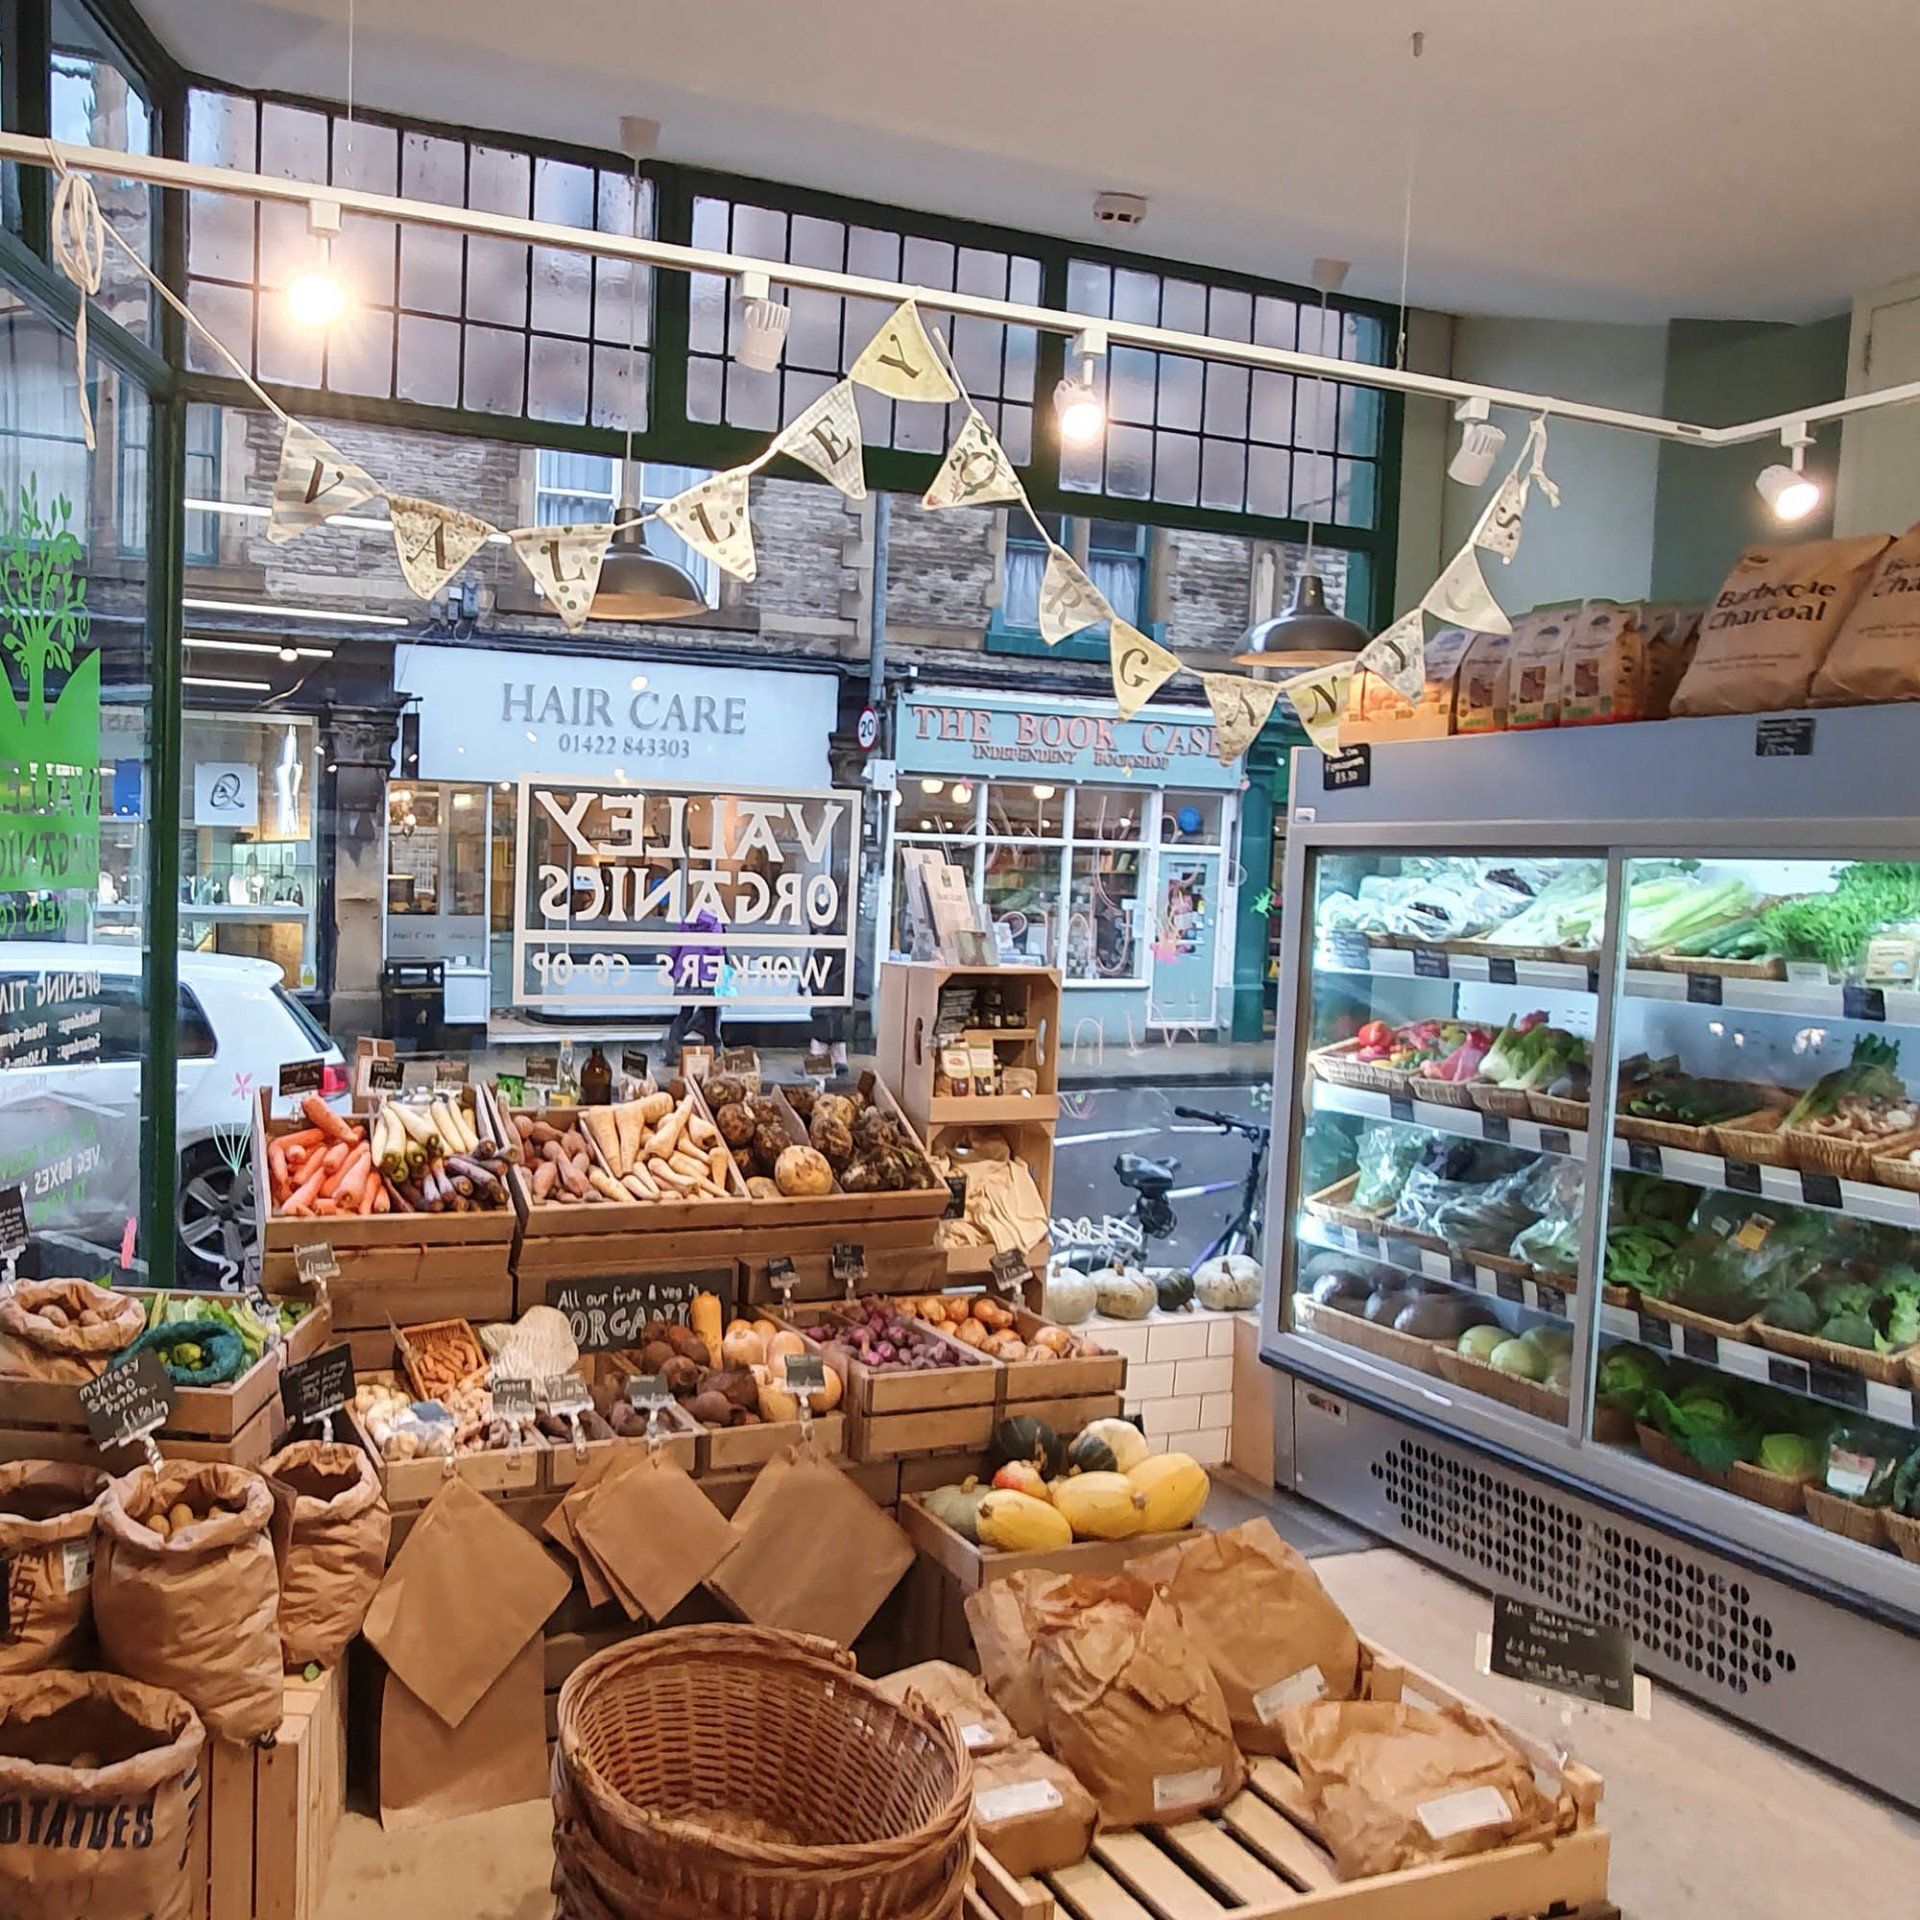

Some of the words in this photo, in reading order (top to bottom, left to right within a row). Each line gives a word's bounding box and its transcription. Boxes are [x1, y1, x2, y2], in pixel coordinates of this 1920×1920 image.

[1708, 601, 1826, 630] Charcoal
[501, 682, 614, 726] HAIR
[629, 690, 748, 735] CARE
[860, 718, 874, 738] 20
[911, 705, 993, 743] THE
[1015, 713, 1119, 752] BOOK
[558, 732, 616, 756] 01422
[622, 735, 691, 759] 843303
[972, 744, 1077, 765] INDEPENDENT
[1093, 752, 1169, 771] BOOKSHOP
[557, 1289, 580, 1310] All
[586, 1293, 608, 1307] our
[612, 1284, 642, 1306] fruit
[661, 1287, 683, 1302] veg
[570, 1302, 692, 1347] ORGANI
[87, 1378, 136, 1414] SALAD
